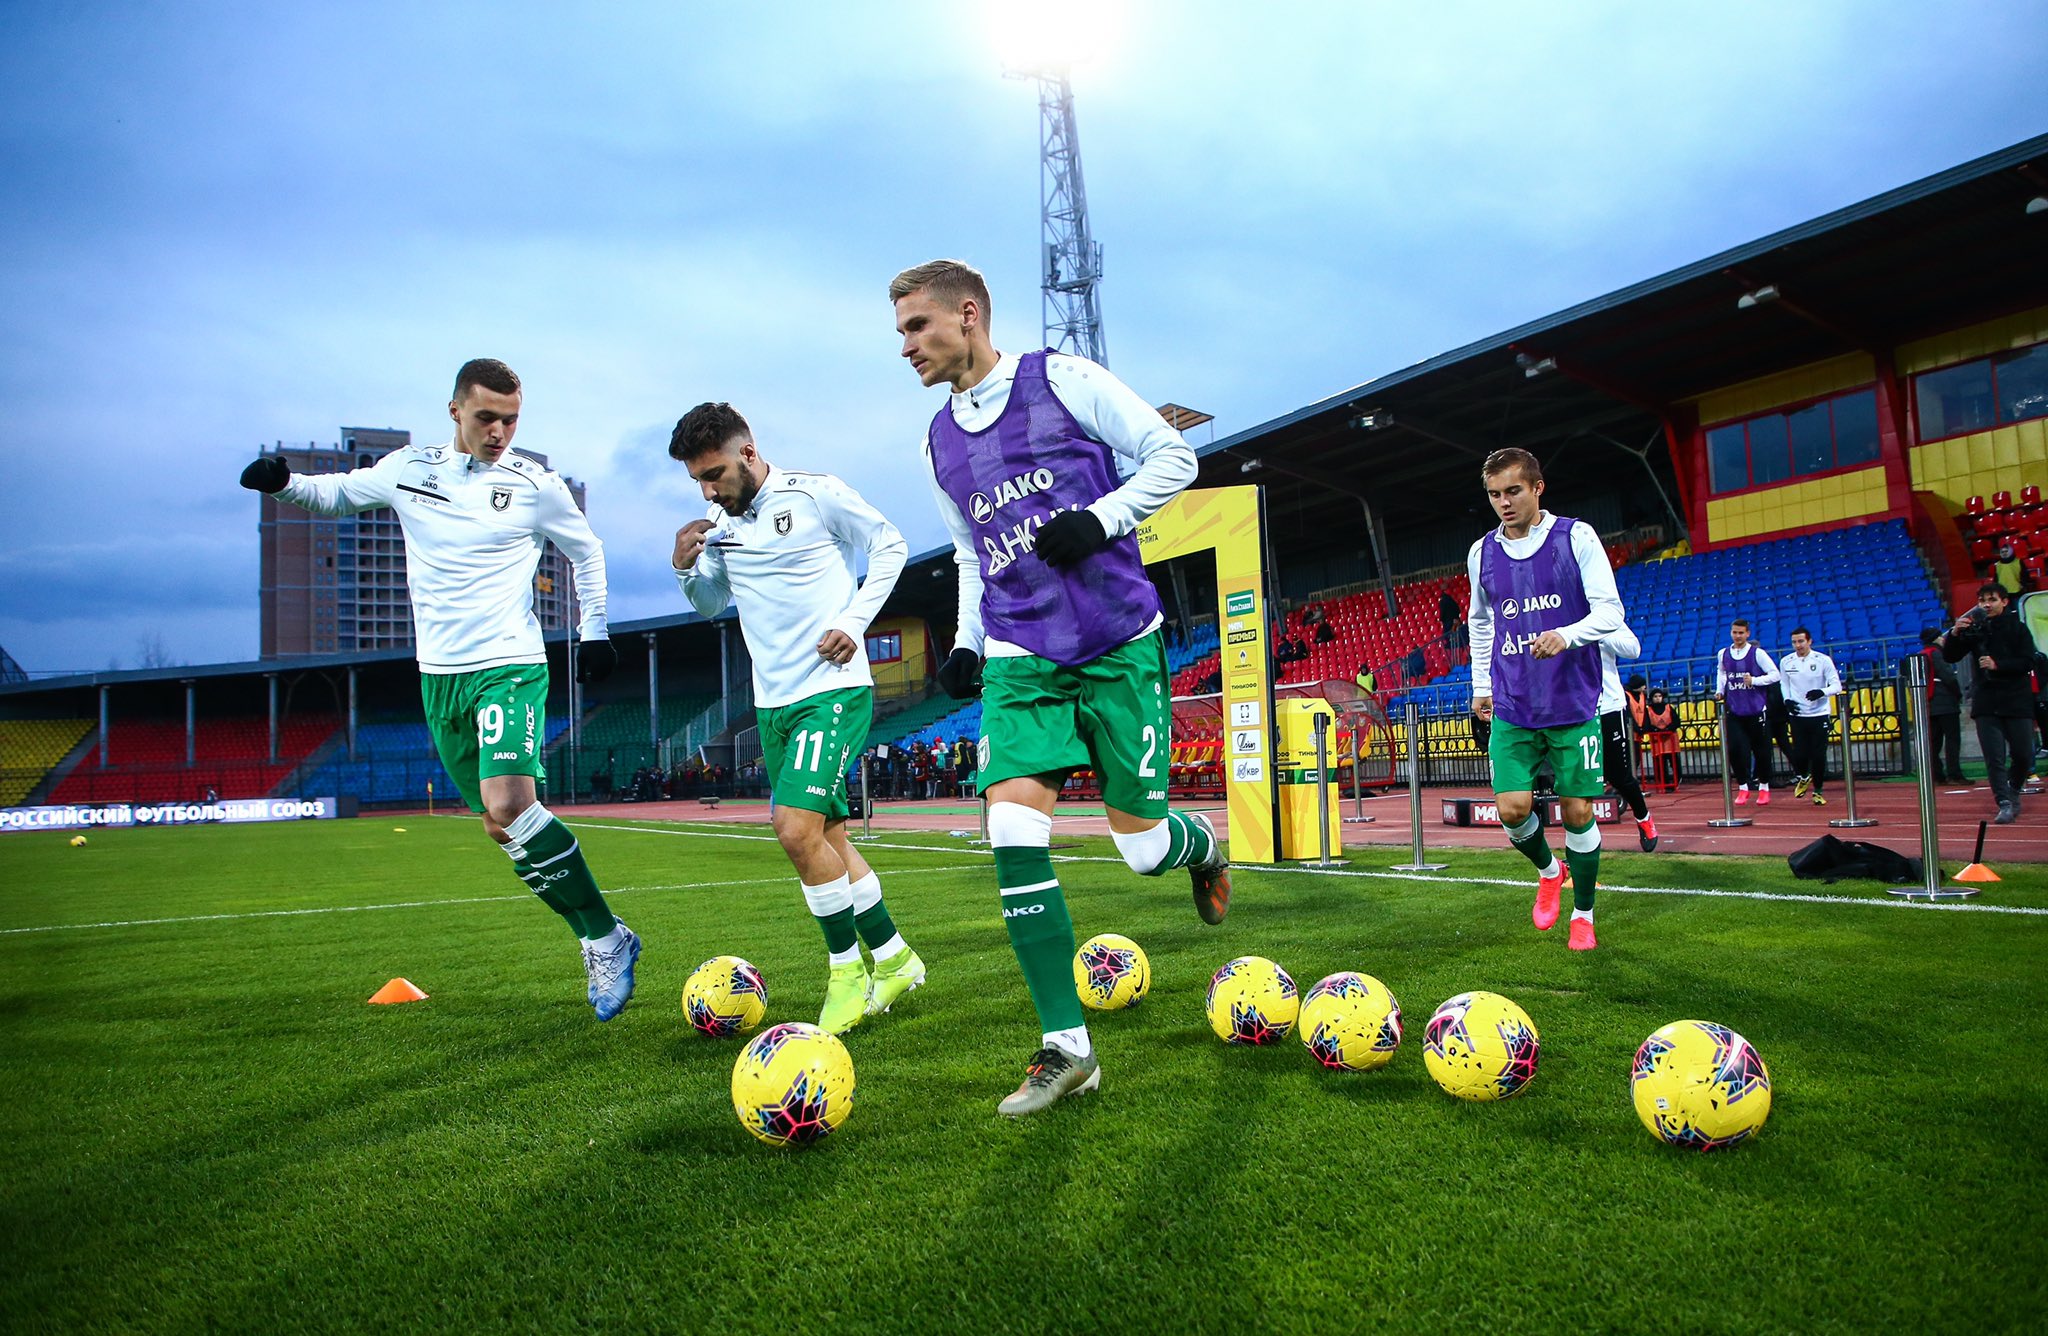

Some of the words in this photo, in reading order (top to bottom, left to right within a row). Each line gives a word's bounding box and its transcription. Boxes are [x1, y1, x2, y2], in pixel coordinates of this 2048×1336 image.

[421, 480, 438, 490] JAKO
[994, 467, 1054, 509] JAKO
[1522, 593, 1562, 613] JAKO
[1231, 682, 1257, 690] ТИНЬКОФФ
[477, 703, 504, 748] 19
[492, 751, 518, 761] JAKO
[793, 729, 824, 773] 11
[1138, 724, 1156, 778] 2
[1579, 735, 1600, 770] 12
[805, 784, 827, 797] JAKO
[1146, 789, 1166, 800] JAKO
[0, 804, 132, 827] РОССИЙСКИЙ
[135, 800, 269, 823] ФУТБОЛЬНЫЙ
[271, 800, 325, 818] СОЮЗ
[1001, 903, 1045, 918] AKO
